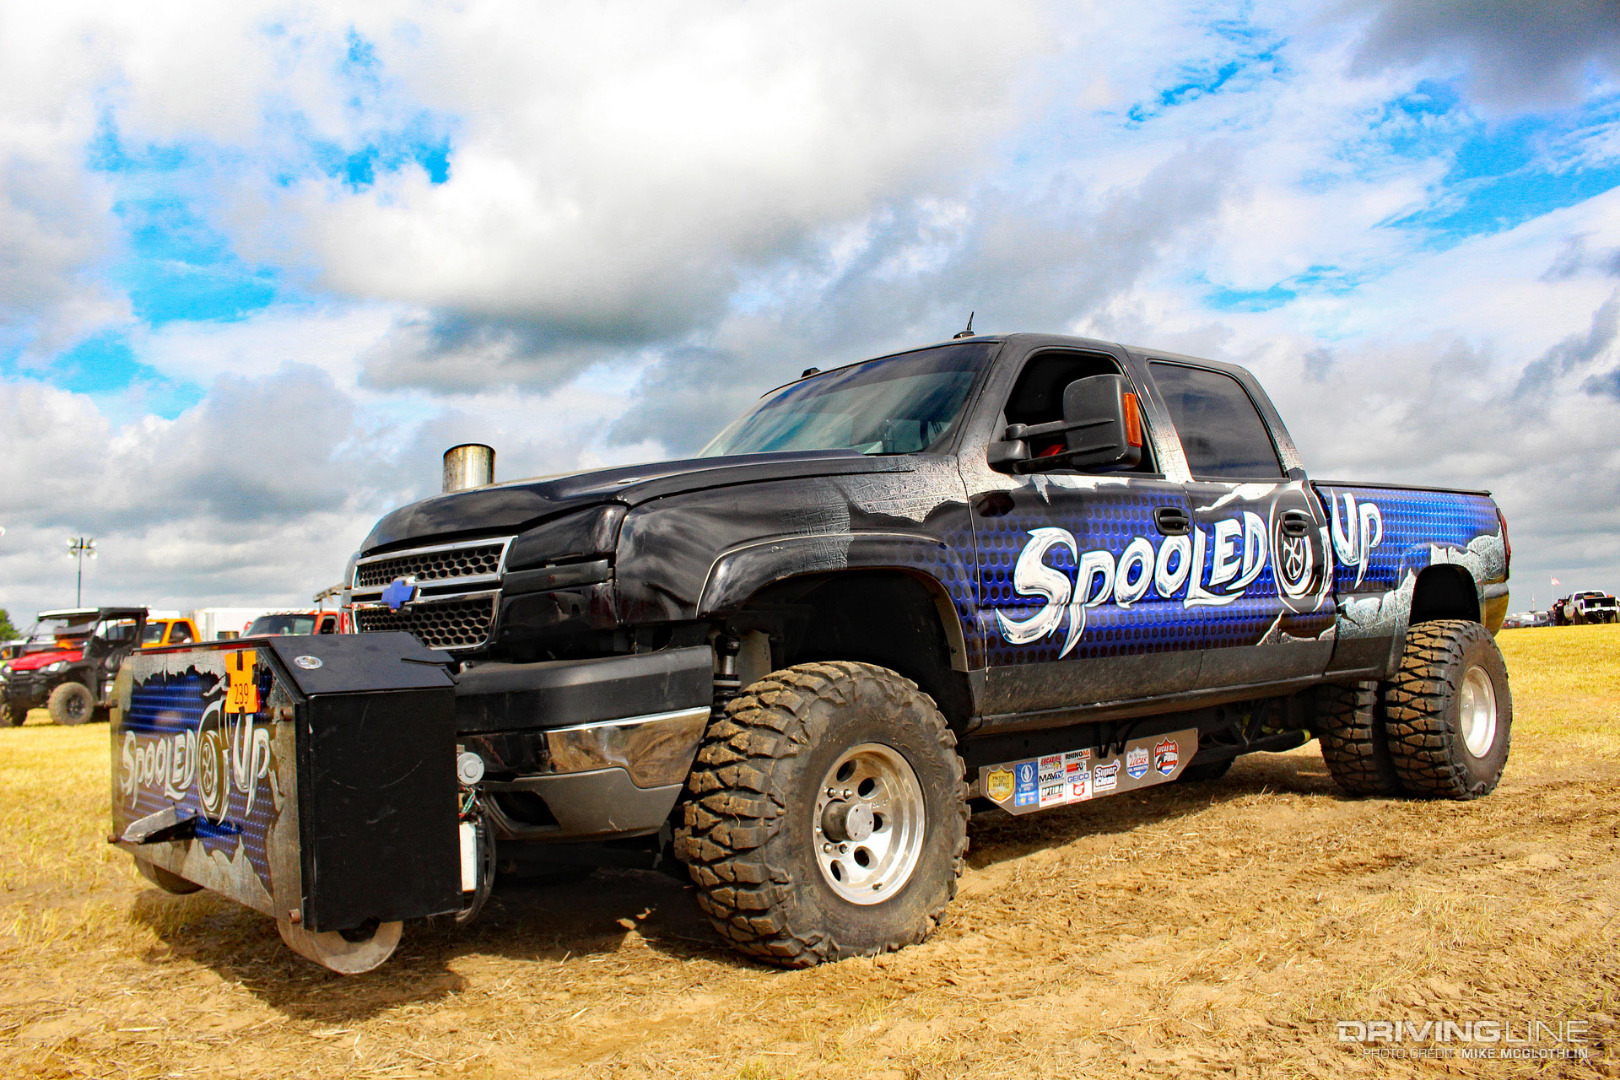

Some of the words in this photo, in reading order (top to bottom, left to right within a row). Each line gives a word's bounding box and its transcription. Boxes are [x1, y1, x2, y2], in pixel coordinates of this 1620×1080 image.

[234, 682, 249, 705] 239
[1067, 772, 1090, 783] GEICO
[1095, 766, 1117, 778] Super
[1095, 776, 1116, 787] Clean
